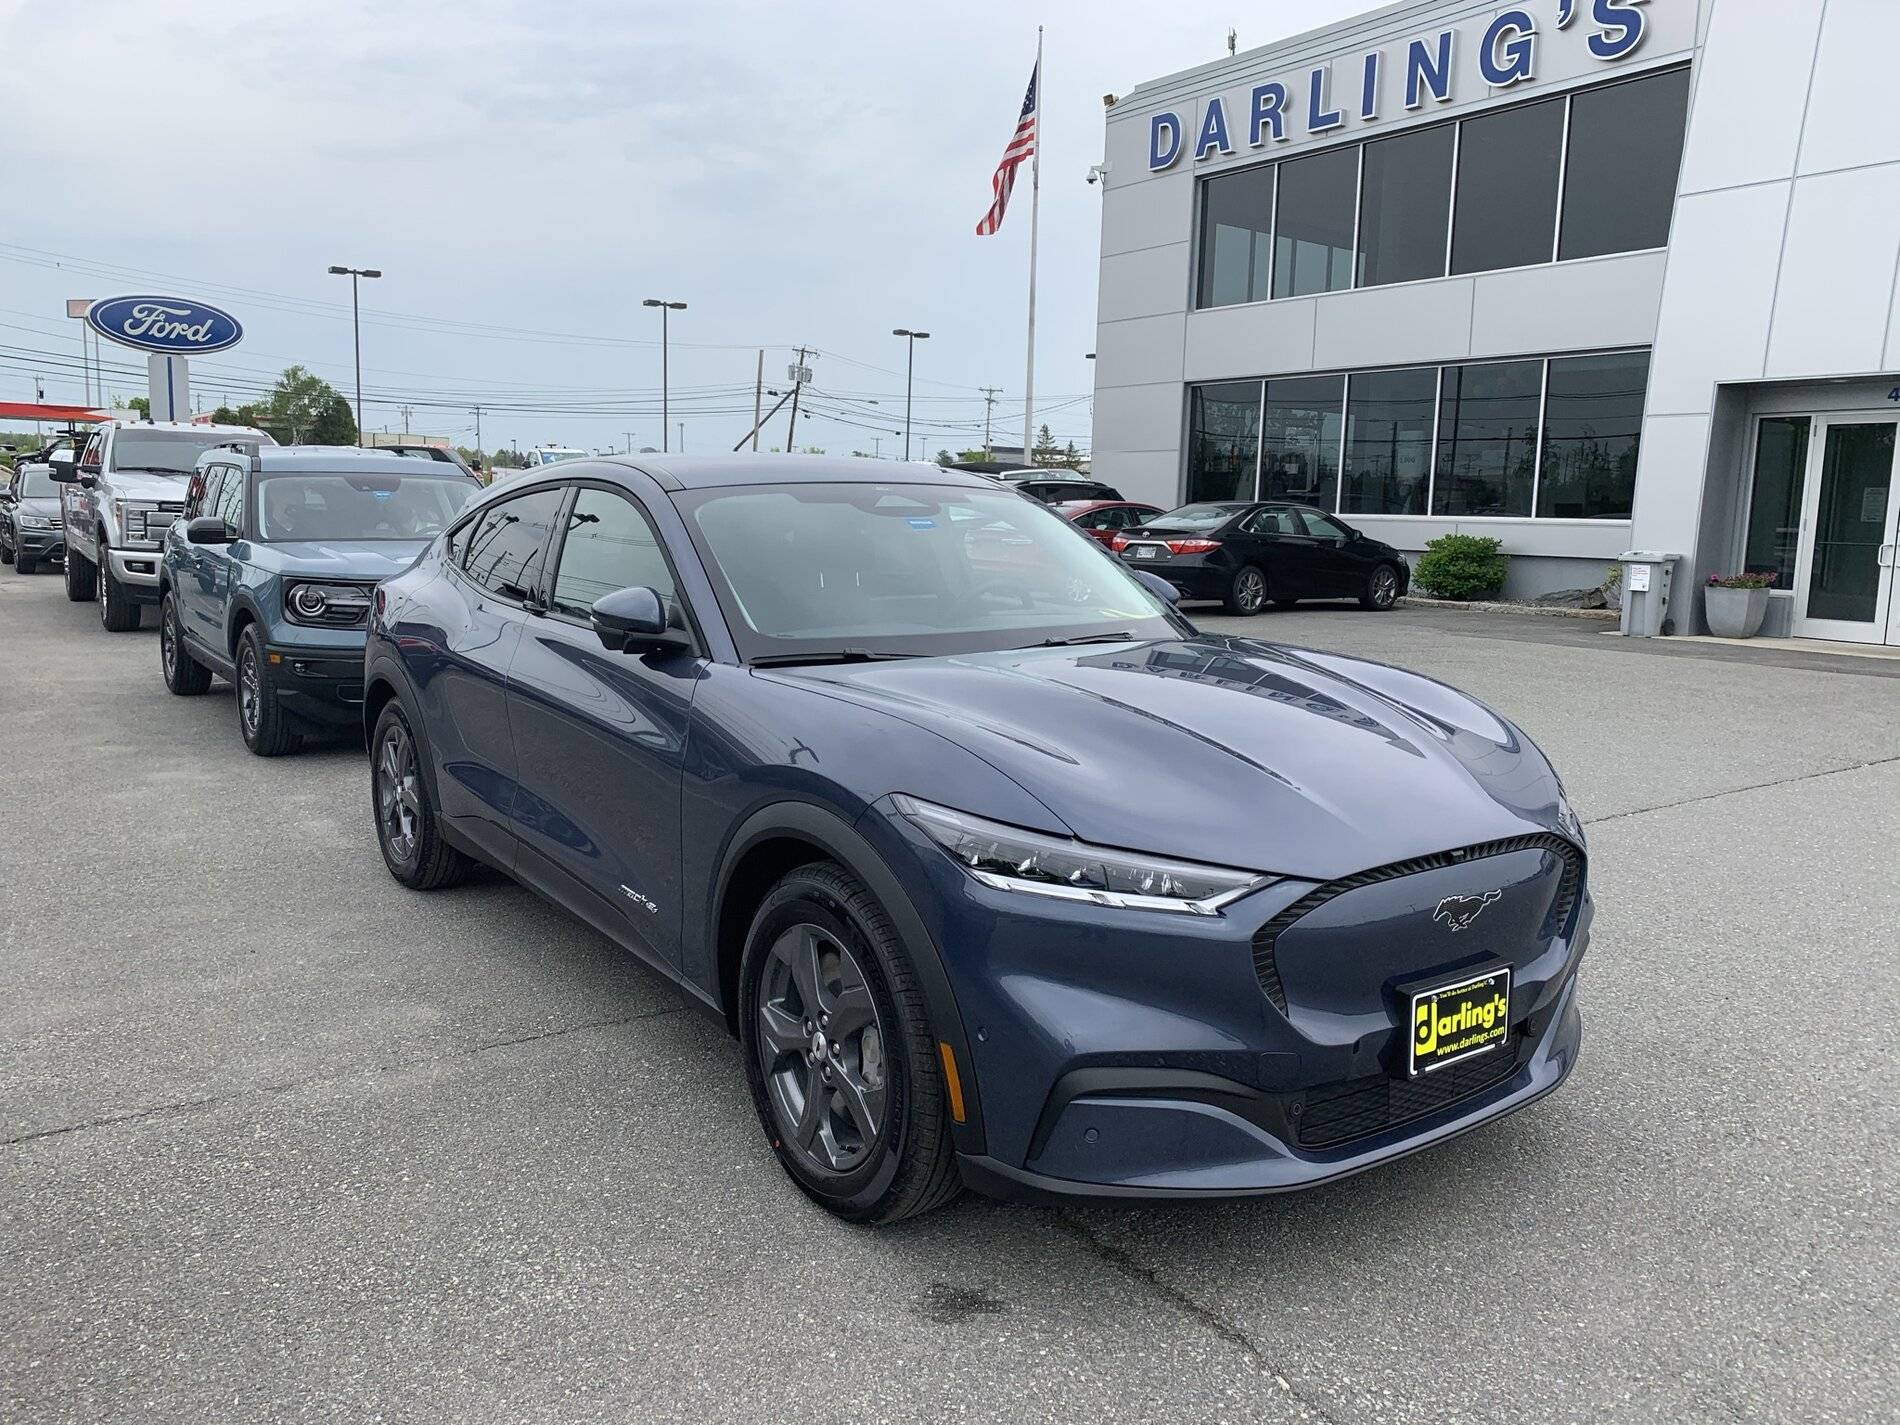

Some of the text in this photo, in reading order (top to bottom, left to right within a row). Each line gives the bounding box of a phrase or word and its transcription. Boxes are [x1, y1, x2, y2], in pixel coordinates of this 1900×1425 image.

[1148, 0, 1649, 172] DARLING'S
[123, 303, 214, 342] Ford
[1416, 993, 1506, 1057] darling's
[1436, 1025, 1505, 1057] www.darlings.com
